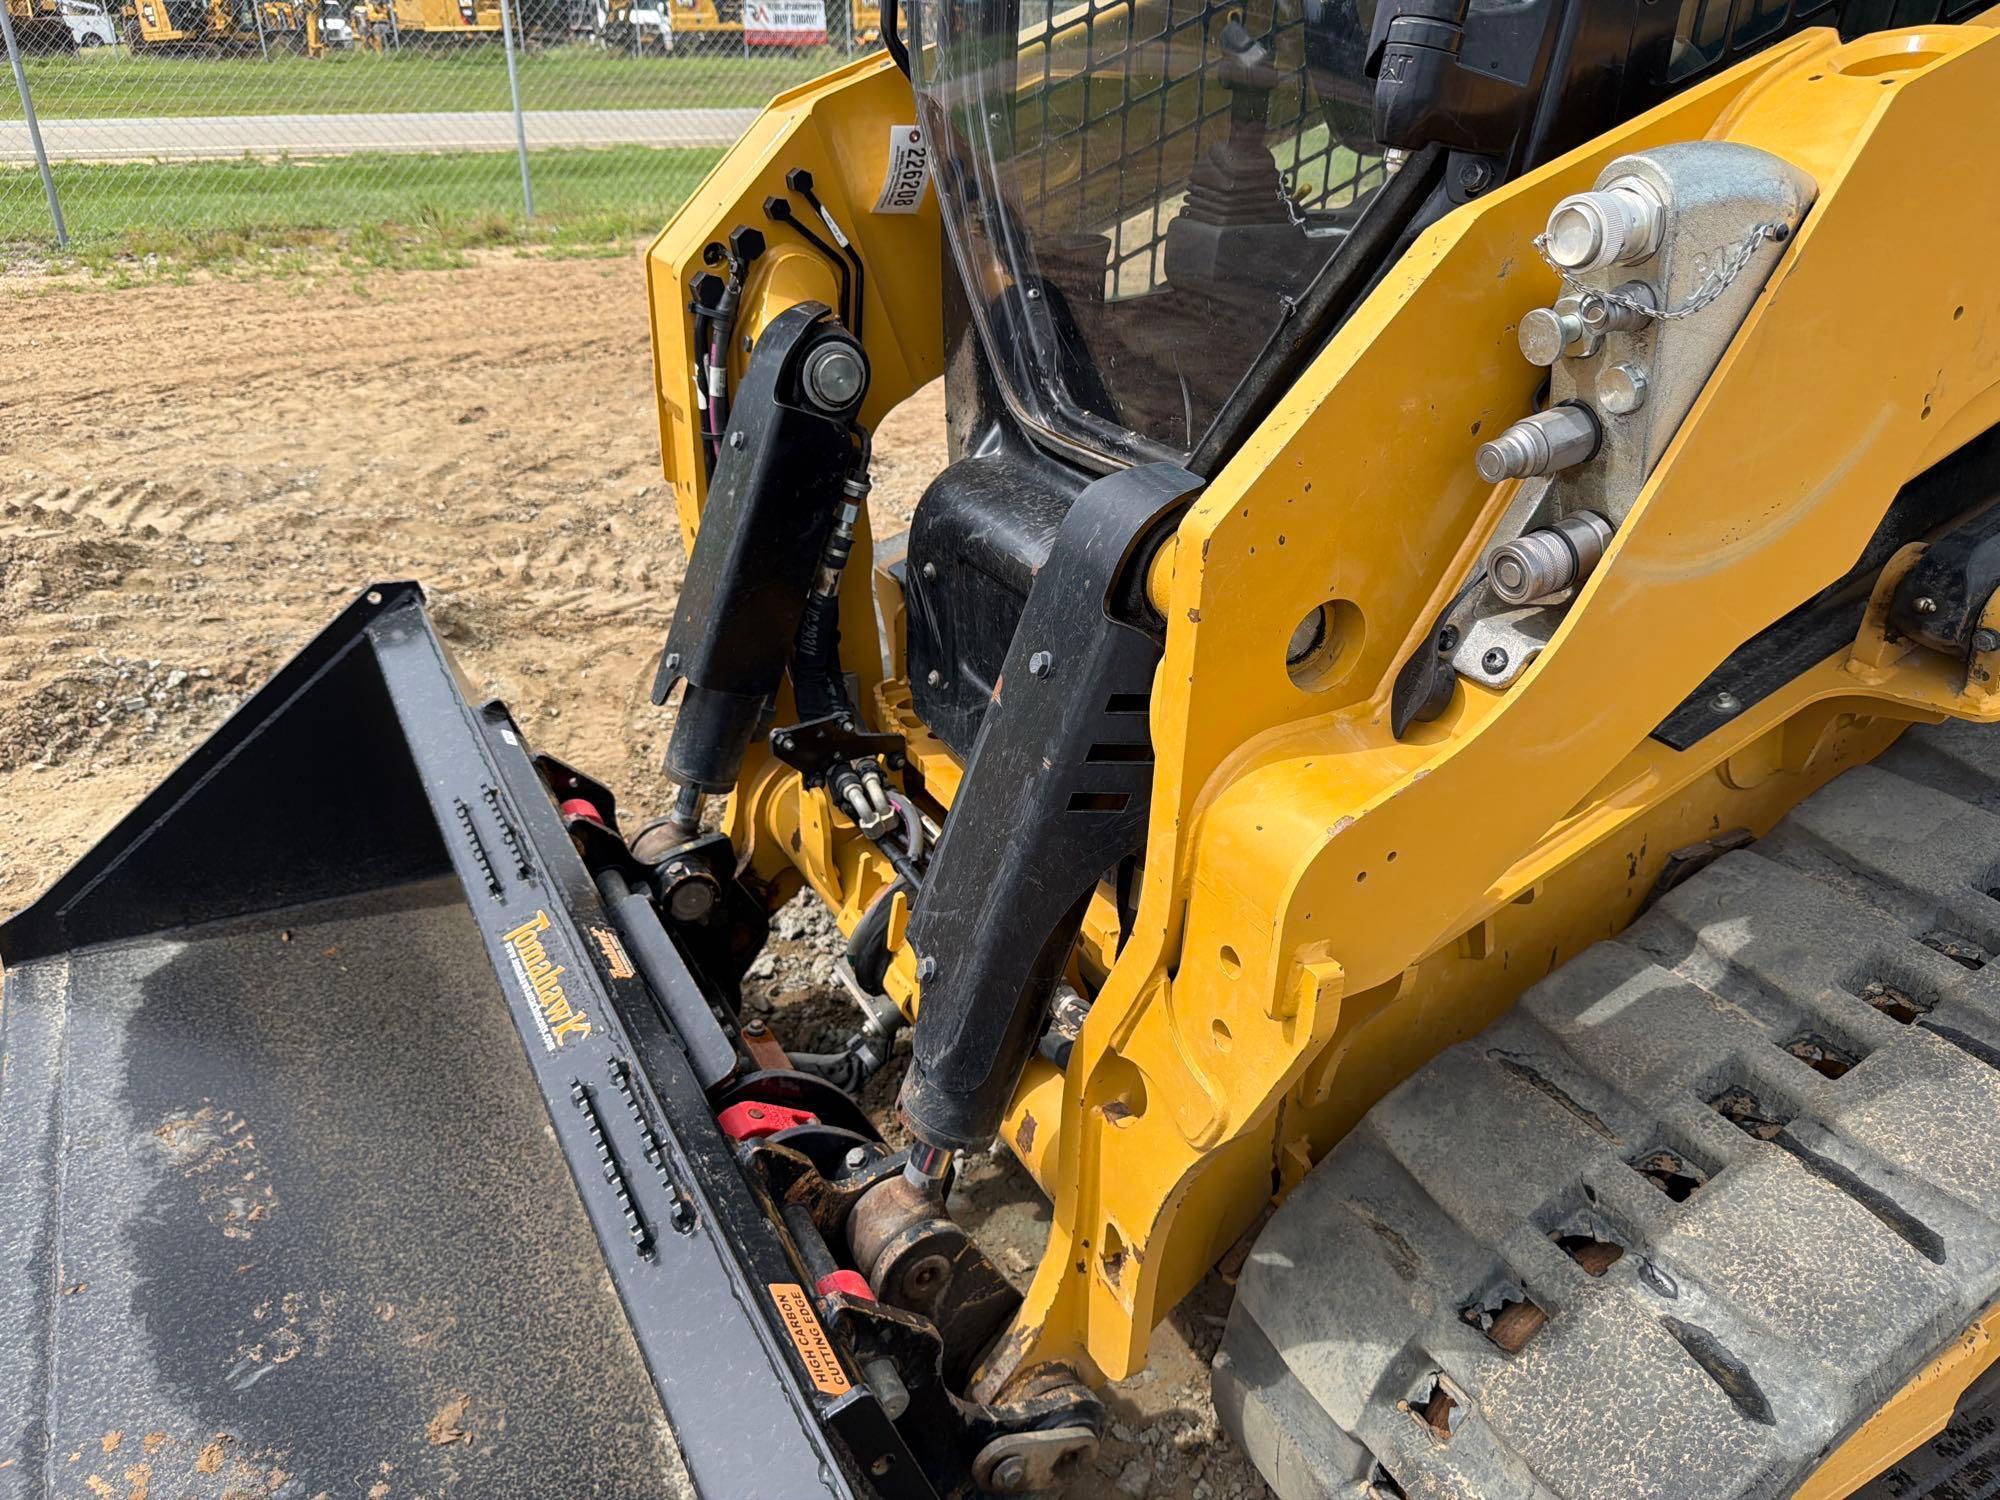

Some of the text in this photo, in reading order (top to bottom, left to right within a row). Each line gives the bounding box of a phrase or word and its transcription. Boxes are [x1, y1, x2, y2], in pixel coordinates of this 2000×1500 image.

[894, 148, 926, 206] 226208
[777, 1294, 828, 1383] HIGH CARBON
[791, 1292, 844, 1385] CUTTING EDGE
